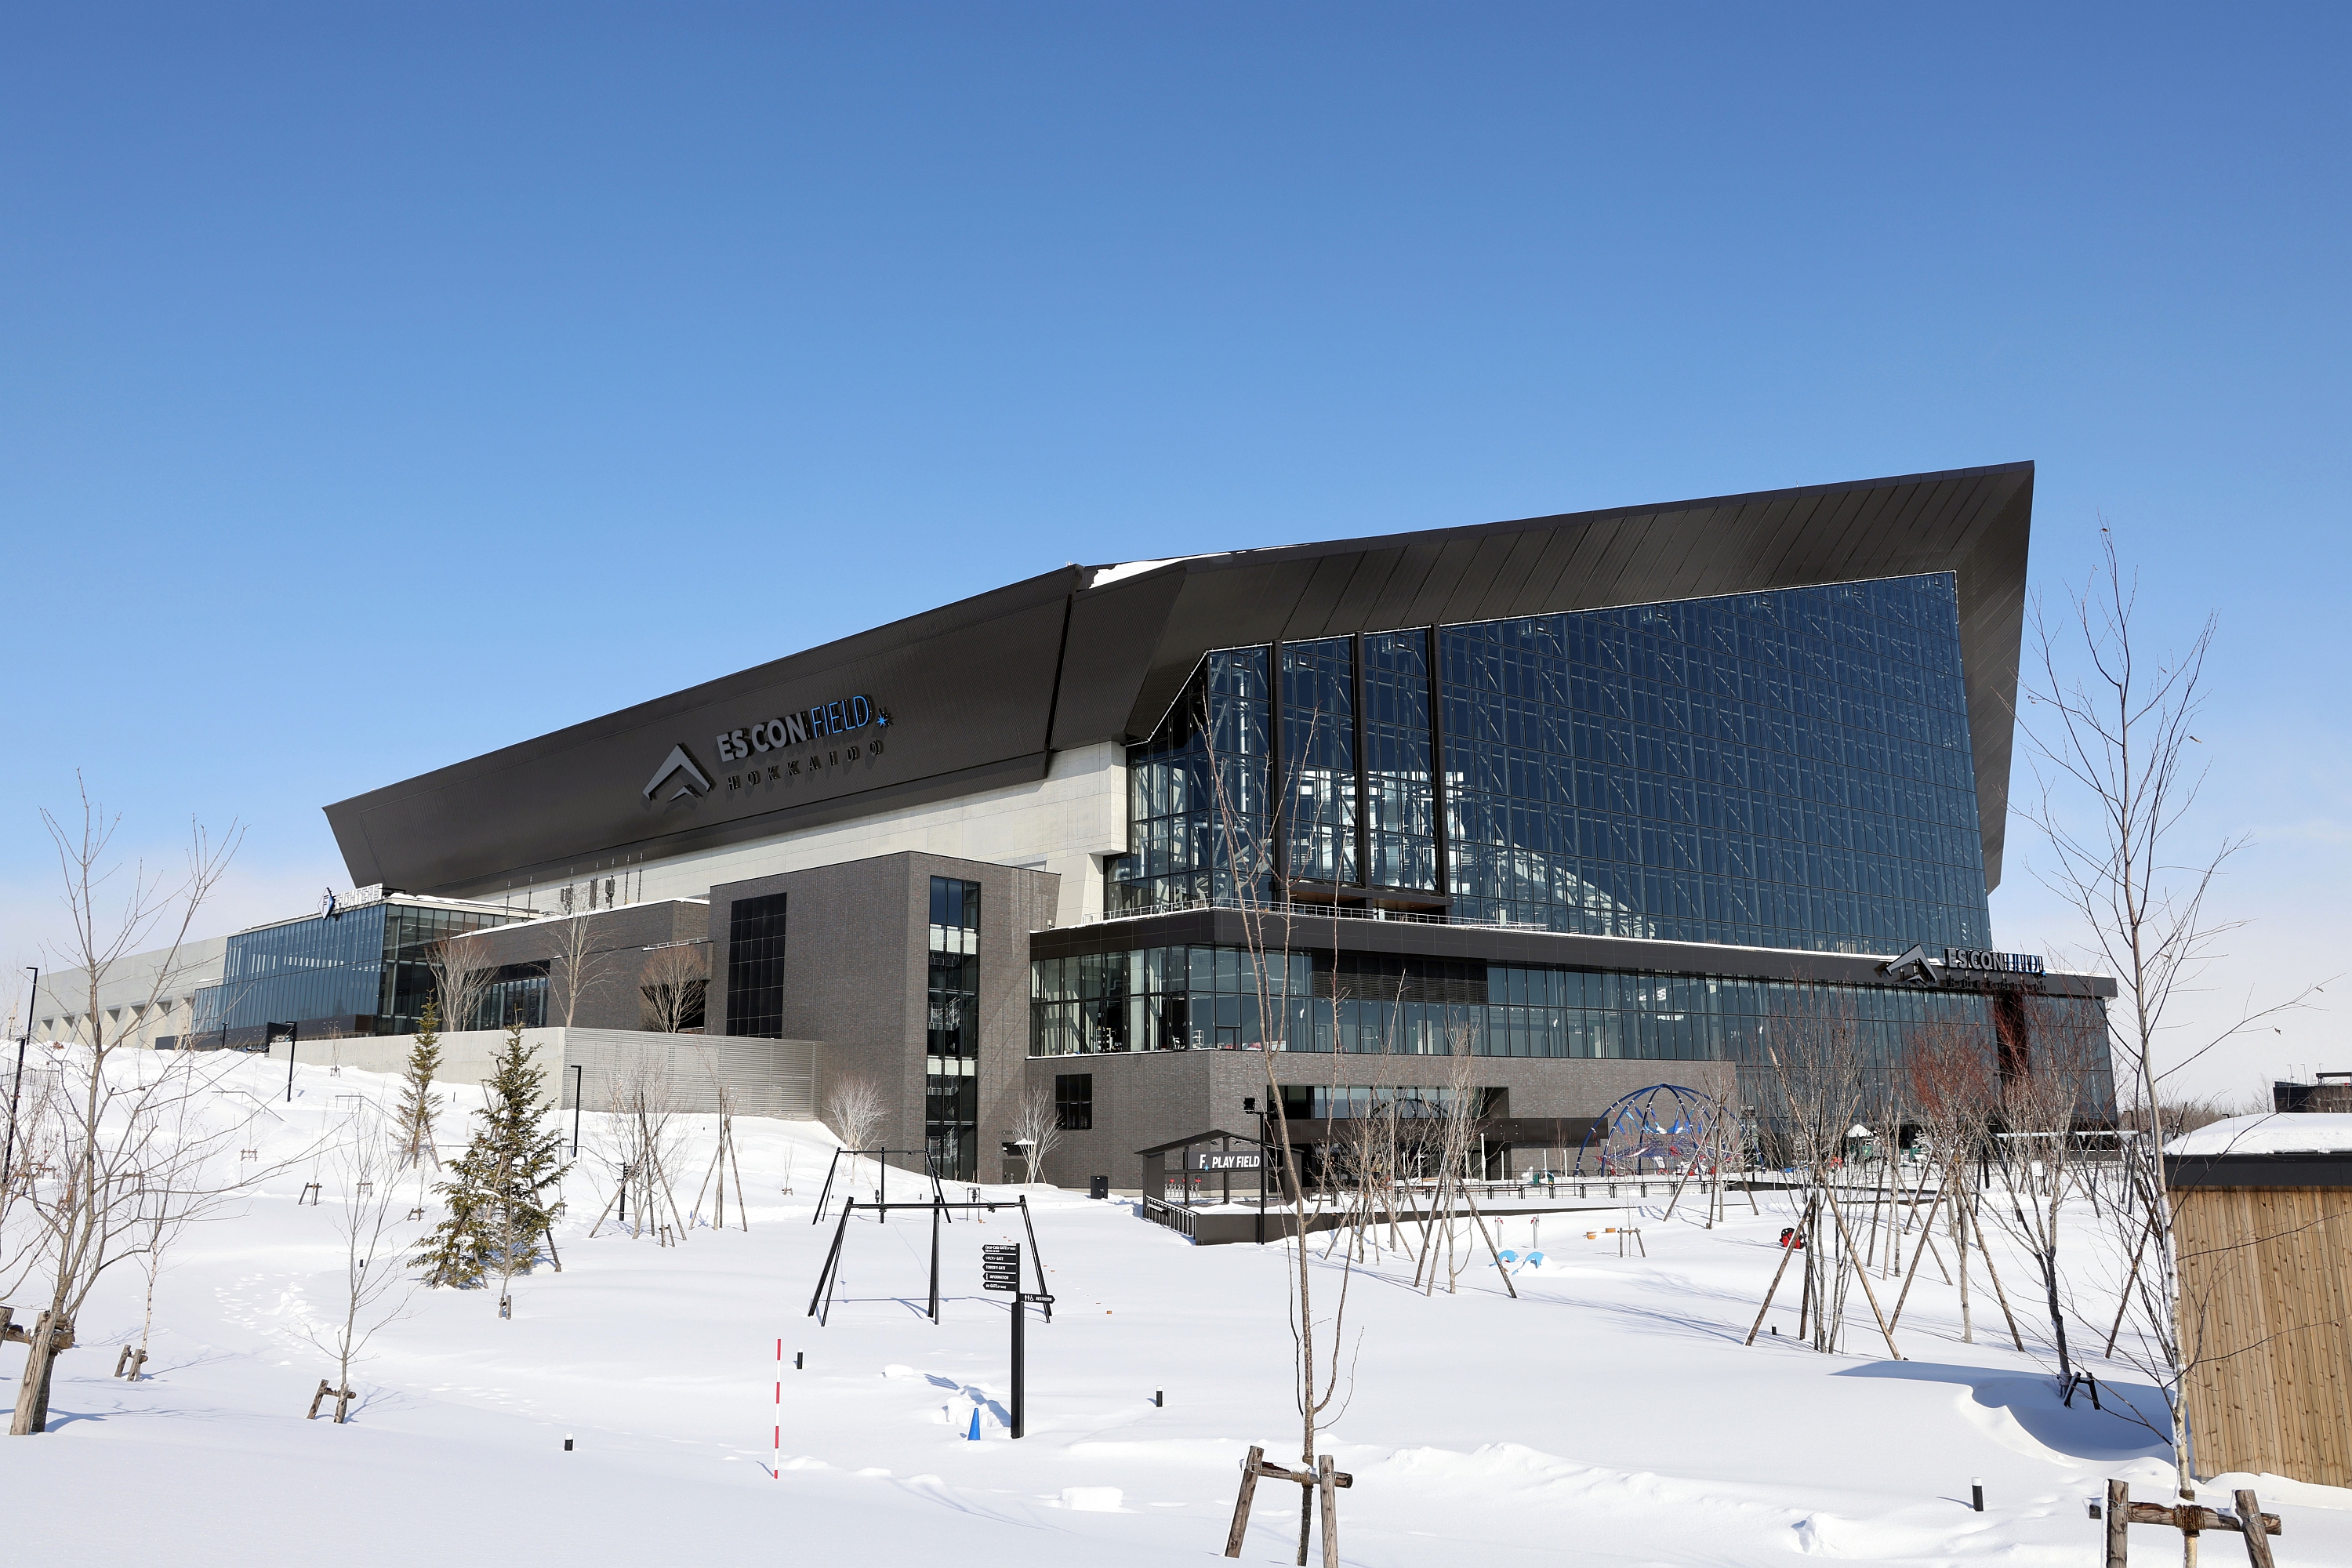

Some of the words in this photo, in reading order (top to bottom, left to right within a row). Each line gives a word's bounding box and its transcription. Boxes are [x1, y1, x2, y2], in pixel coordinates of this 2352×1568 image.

[811, 695, 869, 739] FIELD
[728, 739, 883, 791] HOKKAIDO
[335, 884, 383, 910] FIGHTERS
[2006, 953, 2040, 974] FIELD
[1211, 1156, 1235, 1169] PLAY
[1236, 1156, 1260, 1168] FIELD
